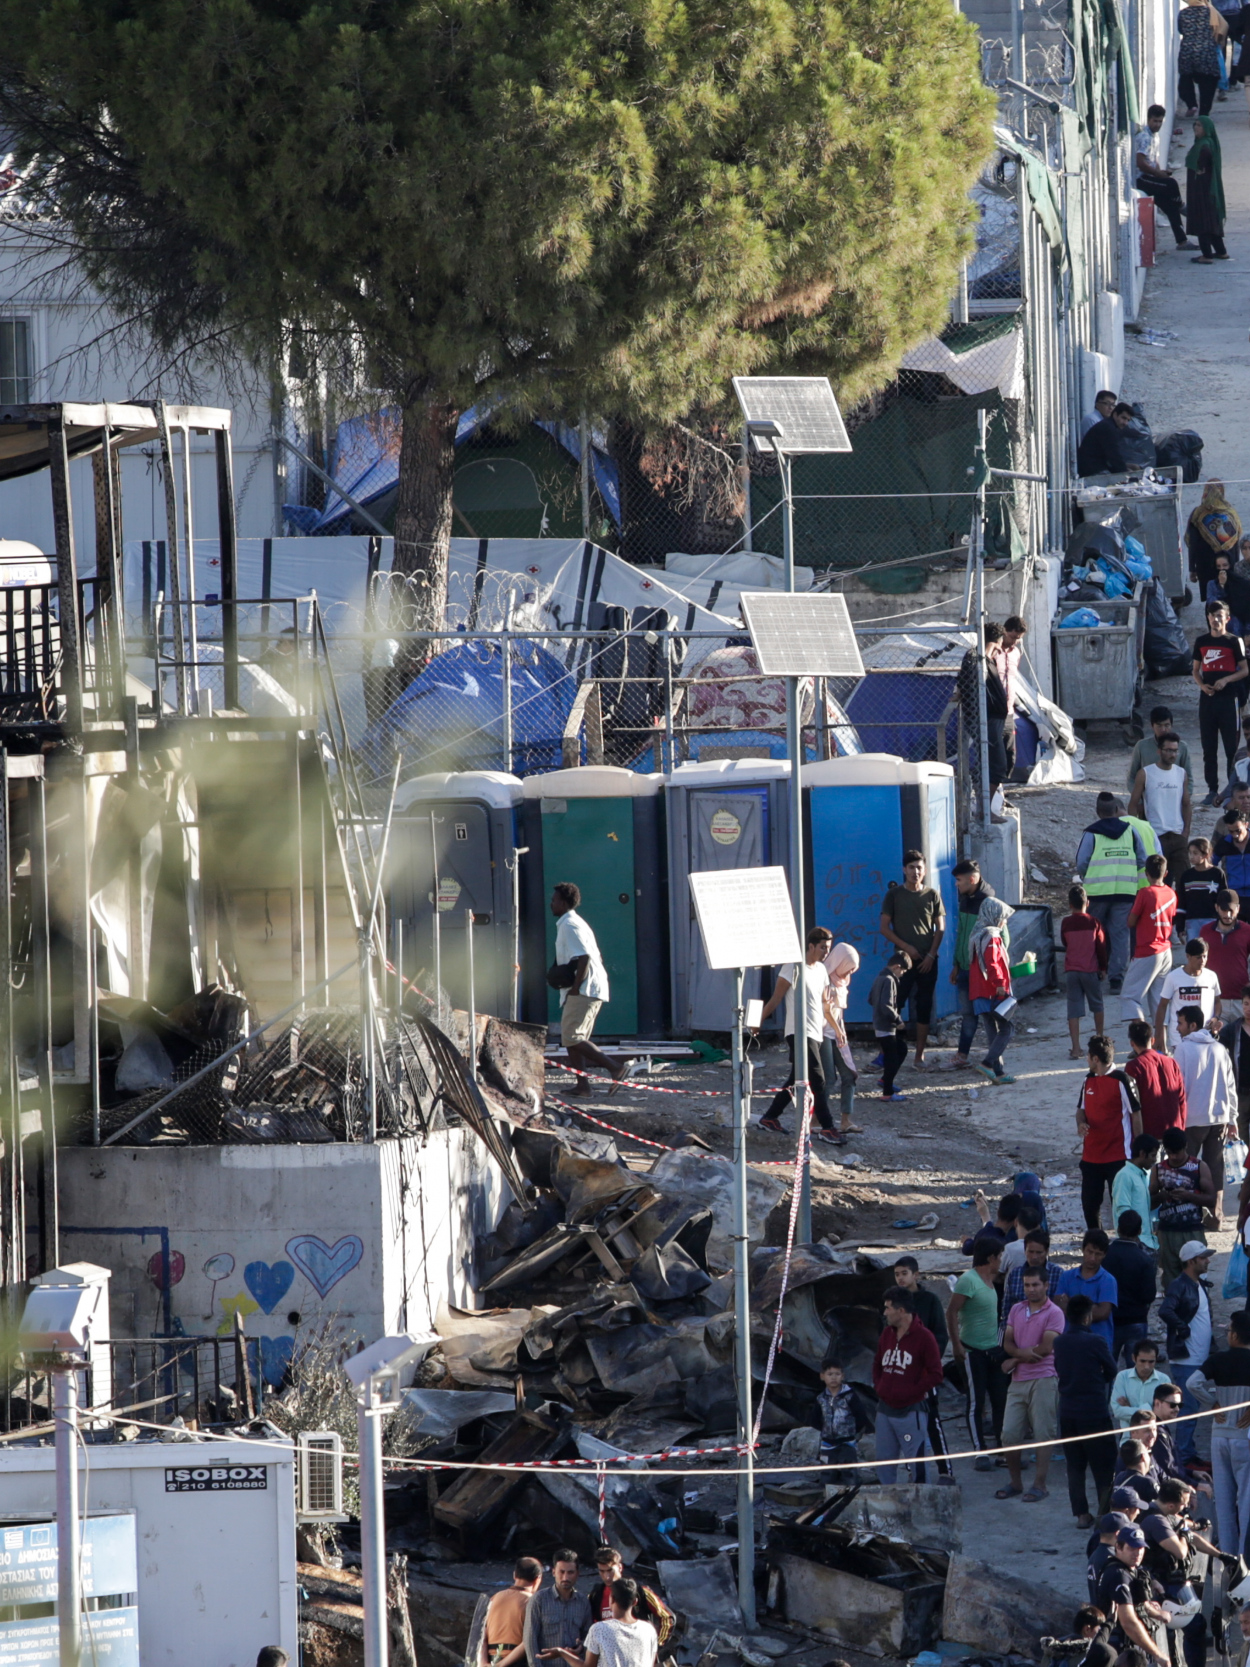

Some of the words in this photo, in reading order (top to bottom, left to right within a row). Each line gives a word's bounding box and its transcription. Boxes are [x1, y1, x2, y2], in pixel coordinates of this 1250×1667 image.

[882, 1348, 912, 1369] GAP
[166, 1467, 265, 1481] ISOBOX
[211, 1481, 266, 1489] 6108880
[38, 1566, 56, 1580] ΤΟΥ
